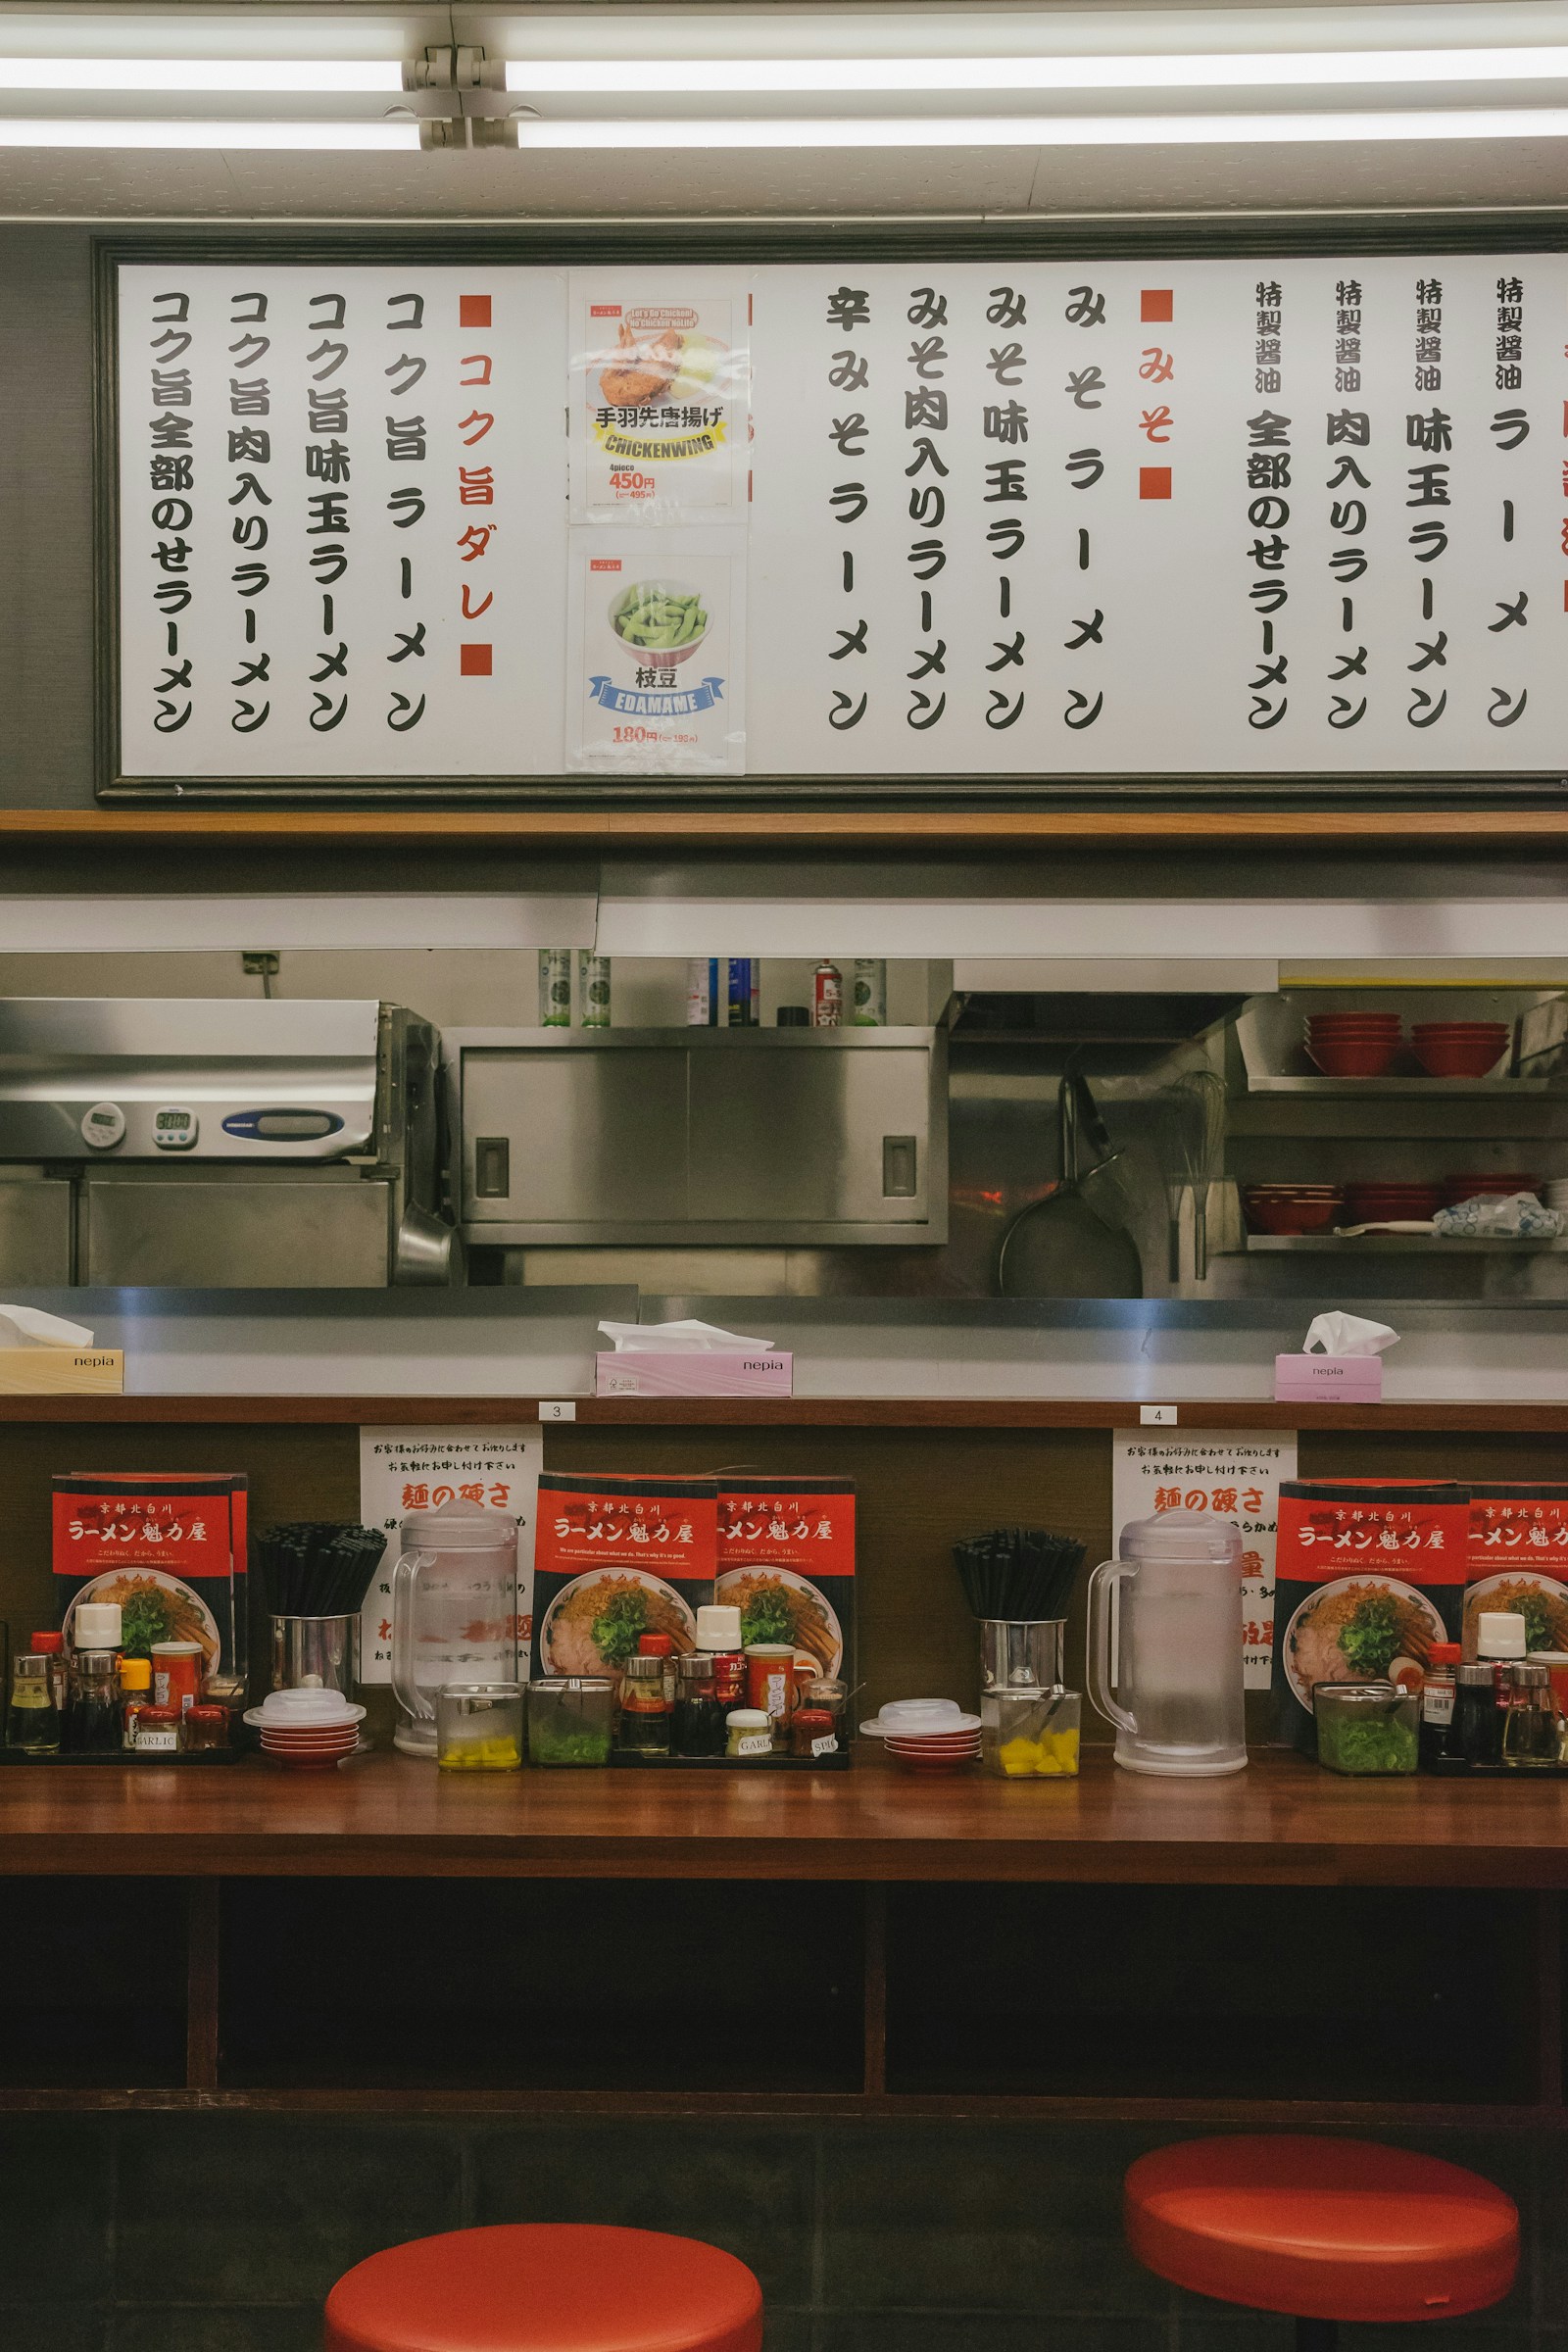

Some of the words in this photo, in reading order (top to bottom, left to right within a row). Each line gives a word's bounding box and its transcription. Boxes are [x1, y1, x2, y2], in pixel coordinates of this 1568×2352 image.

[1139, 347, 1174, 444] みそ
[596, 406, 723, 428] 手羽先唐揚げ
[604, 434, 714, 459] CHICKENWING
[457, 354, 498, 620] コク旨ダレ
[610, 472, 656, 489] 450円
[149, 292, 194, 733] コク旨全部のせラーメン
[227, 292, 272, 733] コク旨肉入りラーメン
[306, 293, 351, 733] コク旨味玉ラーメン
[384, 293, 427, 732] コク旨ラーメン
[826, 286, 870, 731] 辛みそラーメン
[905, 287, 949, 731] みそ肉入りラーメン
[983, 286, 1028, 730] みそ味玉ラーメン
[1064, 285, 1106, 730] みそラーメン
[635, 666, 678, 688] 枝豆
[614, 692, 698, 714] EDAMAME
[74, 1355, 115, 1368] nepia
[743, 1359, 783, 1372] nepia
[1312, 1367, 1344, 1376] nepia
[553, 1405, 562, 1418] 3
[1154, 1409, 1162, 1421] 4
[388, 1460, 515, 1472] お気軽にお申し付け下さい
[1141, 1464, 1269, 1476] お気軽にお申し付け下さい
[402, 1482, 512, 1510] 麺の硬さ
[726, 1500, 799, 1513] 京都北白川
[1153, 1486, 1264, 1513] 麺の硬さ
[99, 1501, 172, 1515] 京都北白川
[588, 1500, 662, 1515] 京都北白川
[1335, 1509, 1411, 1522] 京都北白川
[1485, 1506, 1560, 1519] 京都北白川
[68, 1520, 208, 1543] ラーメン魁力屋
[554, 1518, 694, 1544] ラーメン魁力屋
[1298, 1526, 1445, 1550] ラーメン魁力屋
